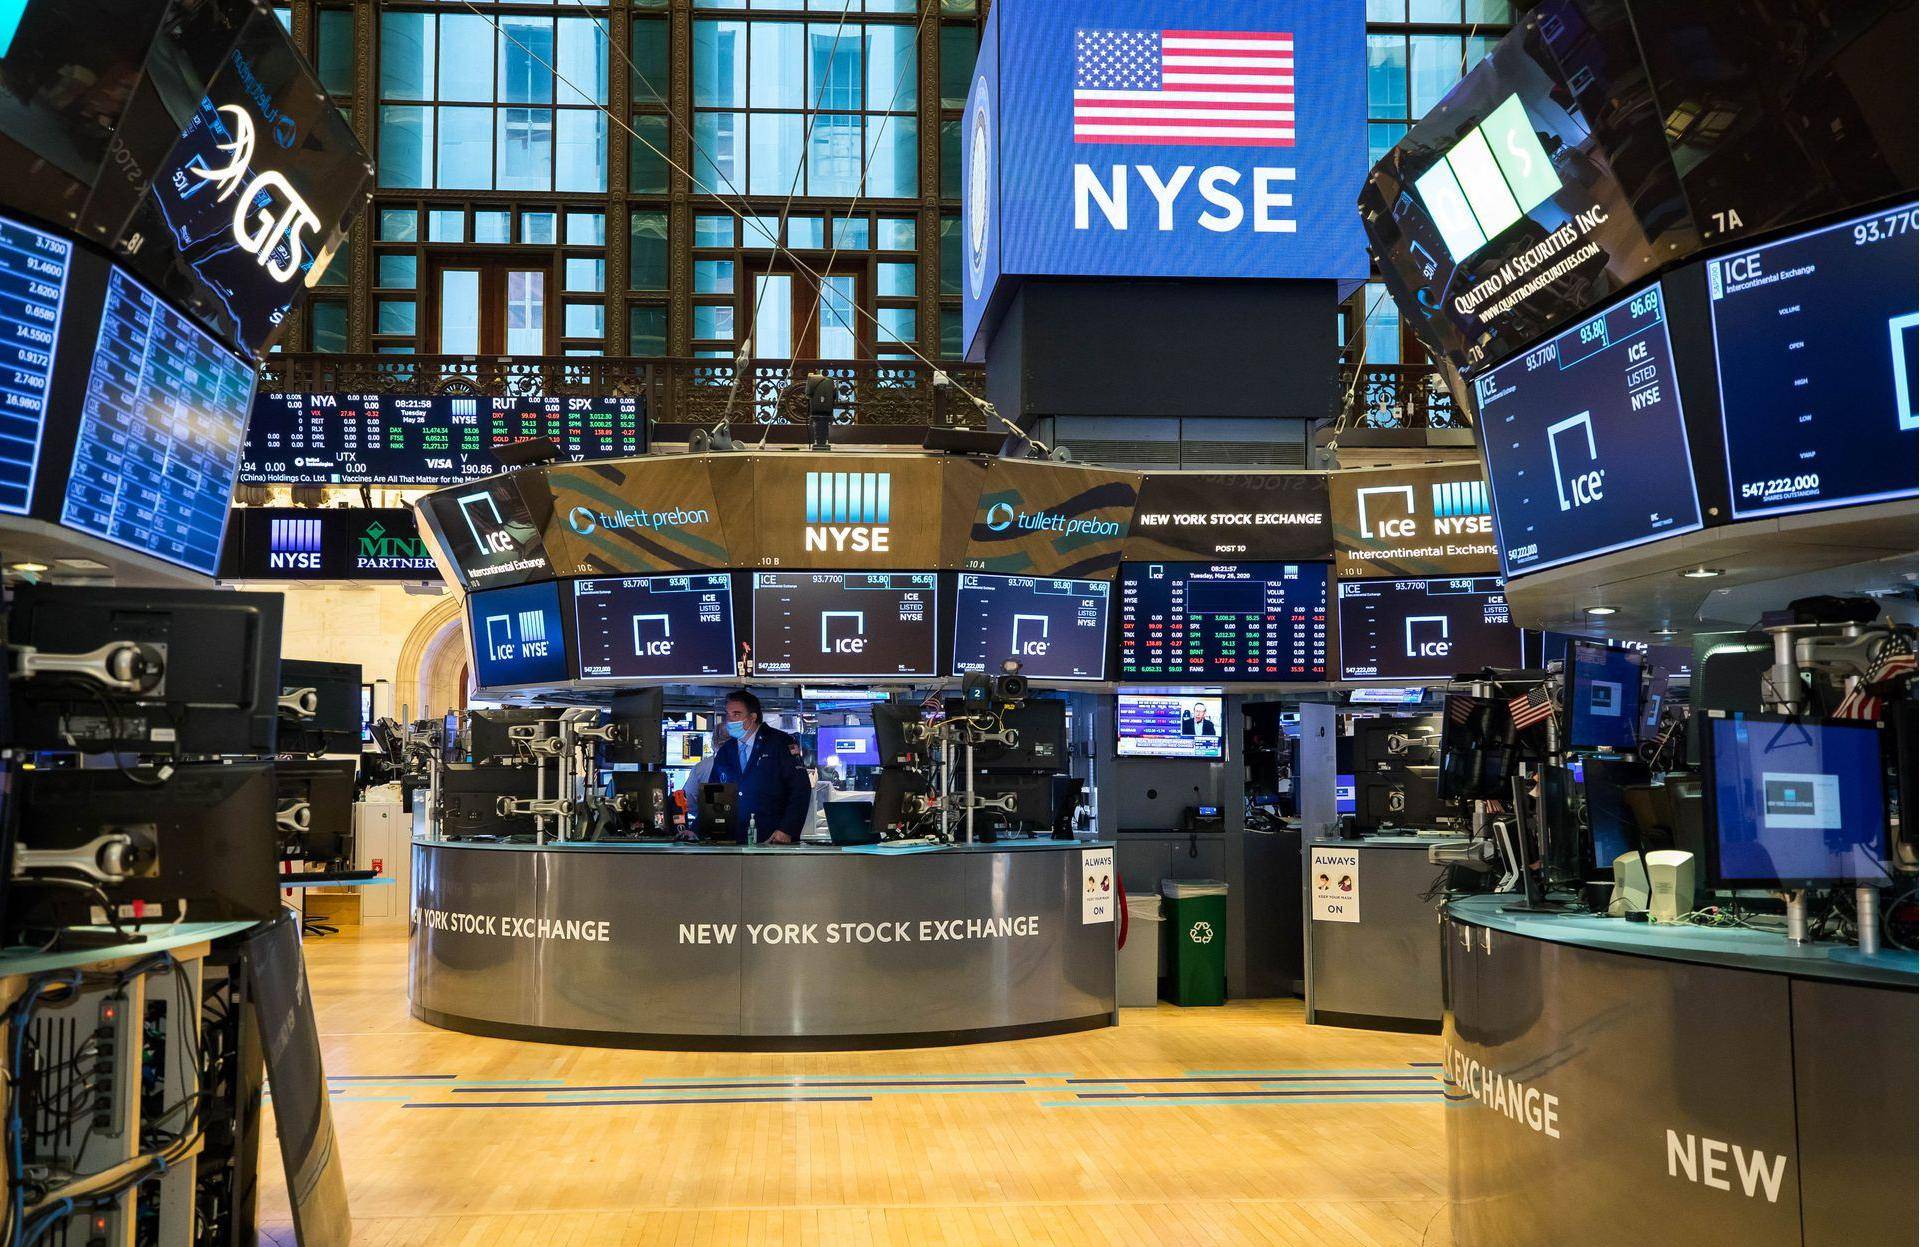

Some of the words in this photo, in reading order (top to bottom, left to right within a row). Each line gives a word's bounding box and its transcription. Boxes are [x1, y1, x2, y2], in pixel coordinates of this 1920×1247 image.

[1074, 164, 1297, 233] NYSE
[1712, 208, 1744, 233] 7A
[233, 170, 322, 284] GTS
[1454, 274, 1503, 314] QUATTRO
[1500, 264, 1517, 286] M
[1512, 223, 1578, 276] SECURITIES
[1575, 204, 1609, 235] INC.
[1724, 253, 1763, 284] ICE
[1726, 273, 1780, 294] Intercontinental
[1780, 264, 1816, 282] Exchange
[1779, 305, 1801, 315] VOLUME
[1481, 375, 1498, 399] ICE
[1526, 343, 1557, 372] 93.7700
[1579, 318, 1605, 345] 93.80
[1630, 291, 1658, 320] 96.69
[1469, 344, 1485, 362] 7B
[1627, 341, 1648, 363] ICE
[1626, 365, 1657, 388] LISTED
[311, 395, 337, 407] NYA
[395, 400, 432, 408] 08:21:58
[492, 397, 518, 410] RUT
[568, 398, 592, 411] SPX
[1631, 386, 1661, 412] NYSE
[452, 416, 478, 424] NYSE
[336, 452, 357, 462] UTX
[460, 453, 468, 462] V
[265, 462, 286, 472] 0.00
[346, 463, 367, 473] 0.00
[425, 458, 453, 469] VISA
[461, 464, 492, 474] 190.86
[240, 474, 266, 482] (China)
[268, 474, 299, 483] Holdings
[342, 475, 373, 483] Vaccines
[374, 475, 386, 483] Are
[387, 475, 398, 483] All
[399, 475, 415, 483] That
[416, 475, 439, 484] Matter
[1742, 473, 1820, 498] 547,222,000
[600, 509, 650, 529] tullett
[652, 507, 709, 531] prebon
[1018, 511, 1066, 532] tullett
[1065, 519, 1119, 537] prebon
[1141, 514, 1170, 525] NEW
[1173, 514, 1208, 525] YORK
[1210, 513, 1252, 525] STOCK
[1255, 513, 1322, 524] EXCHANGE
[1434, 515, 1493, 536] NYSE
[805, 526, 889, 552] NYSE
[1348, 546, 1444, 560] Intercontinental
[1446, 544, 1499, 556] Exchang
[270, 552, 321, 569] NYSE
[357, 557, 438, 568] PARTNER
[761, 558, 772, 566] 10
[774, 558, 780, 566] B
[969, 560, 979, 569] 10
[979, 561, 985, 569] A
[468, 561, 515, 578] Intercontinental
[513, 557, 546, 571] Exchange
[577, 564, 586, 573] 10
[586, 563, 593, 572] C
[1345, 568, 1355, 576] 10
[580, 582, 594, 591] ICE
[623, 579, 649, 588] 93.7700
[669, 577, 688, 586] 93.80
[760, 574, 777, 585] ICE
[812, 575, 843, 583] 93.7700
[867, 575, 889, 583] 93.80
[964, 576, 978, 586] ICE
[1008, 578, 1034, 588] 93.7700
[1053, 581, 1070, 590] 93.80
[1345, 584, 1361, 594] ICE
[1395, 582, 1426, 591] 93.7700
[1450, 580, 1471, 589] 93.80
[702, 594, 716, 602] ICE
[1488, 596, 1503, 604] ICE
[699, 604, 721, 612] LISTED
[899, 603, 923, 611] LISTED
[1077, 609, 1097, 617] LISTED
[1484, 606, 1508, 614] LISTED
[700, 614, 721, 622] NYSE
[899, 613, 923, 621] NYSE
[1077, 619, 1096, 627] NYSE
[522, 641, 549, 658] NYSE
[974, 689, 981, 698] 2
[1085, 857, 1112, 866] ALWAYS
[1315, 857, 1356, 865] ALWAYS
[1093, 907, 1104, 915] ON
[1328, 905, 1343, 913] ON
[424, 908, 449, 930] YORK
[451, 912, 496, 936] STOCK
[501, 917, 610, 942] EXCHANGE
[679, 923, 737, 944] NEW
[746, 923, 818, 945] YORK
[826, 921, 911, 943] STOCK
[919, 915, 1039, 941] EXCHANGE
[1455, 1048, 1560, 1139] EXCHANGE
[1666, 1129, 1787, 1203] NEW
